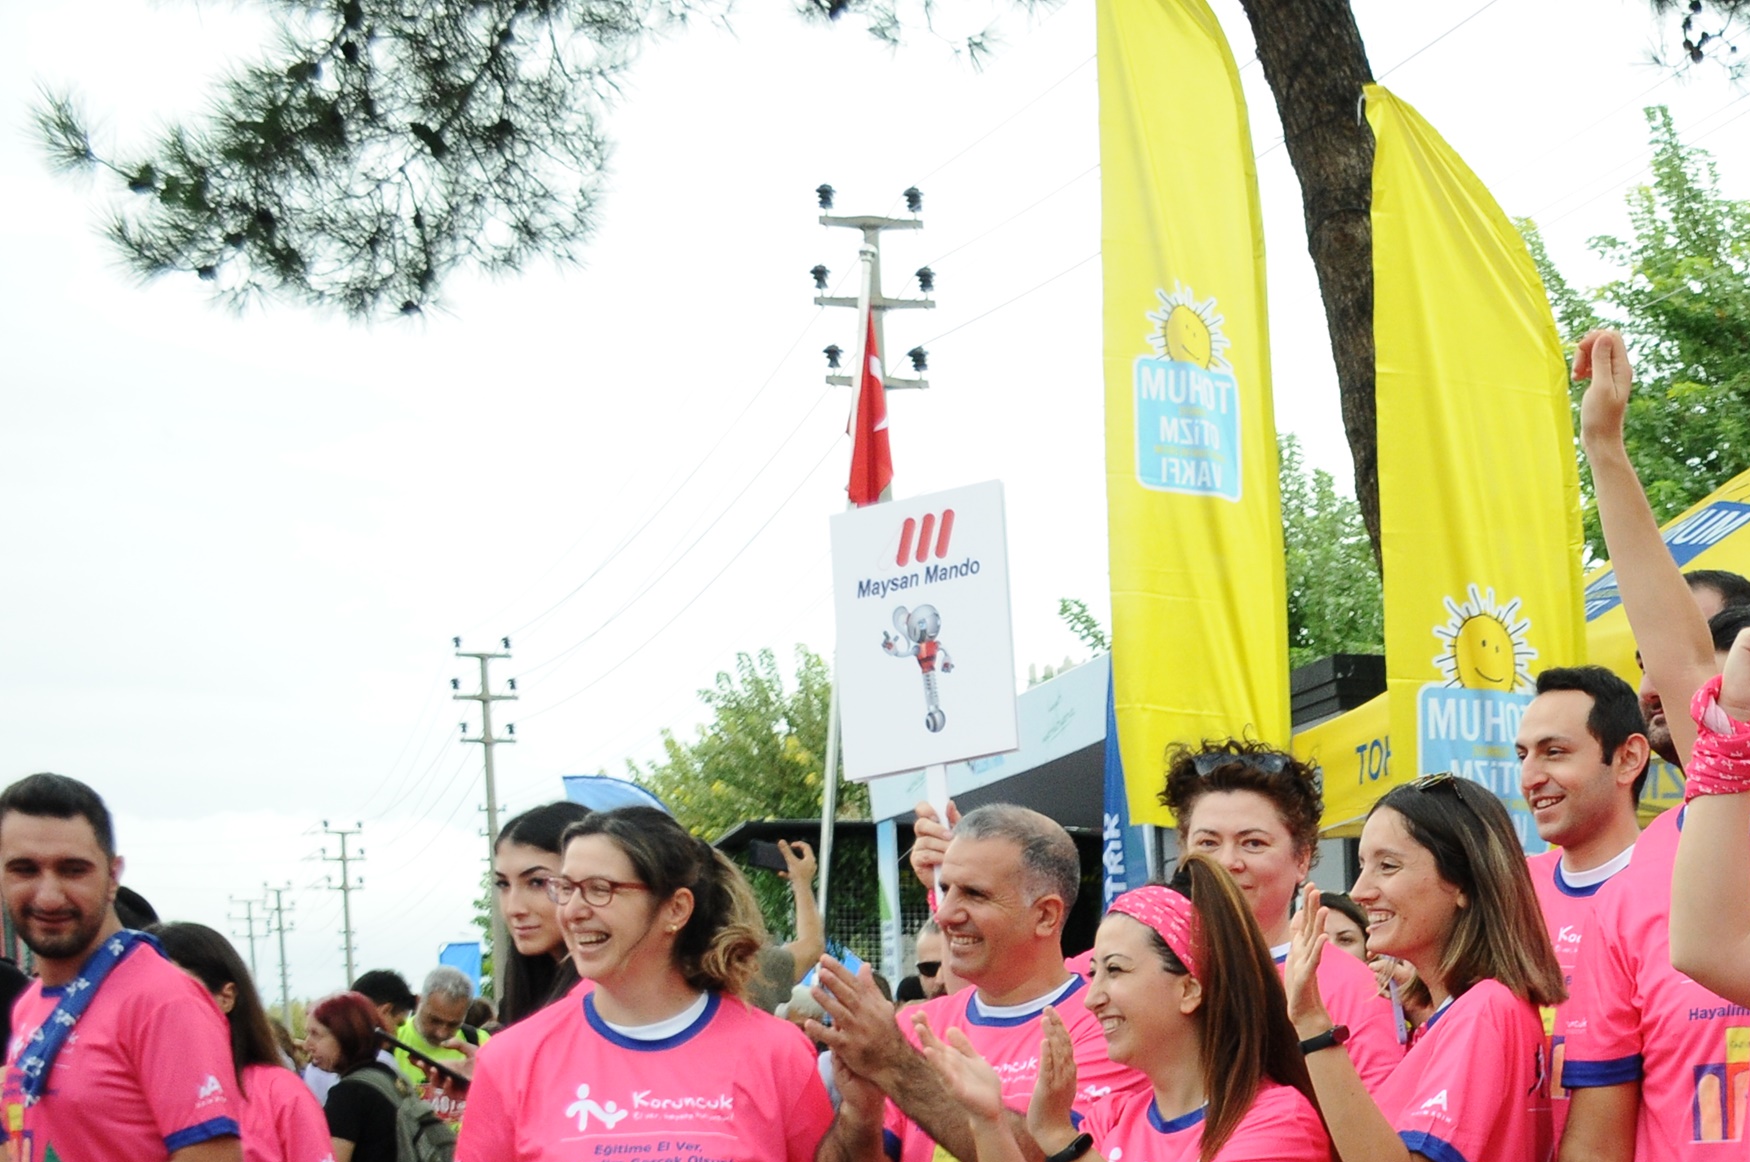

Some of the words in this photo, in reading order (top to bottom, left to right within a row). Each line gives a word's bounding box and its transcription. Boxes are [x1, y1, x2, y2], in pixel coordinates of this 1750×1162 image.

[857, 572, 919, 600] Maysan
[924, 558, 980, 585] Mando
[1688, 1003, 1750, 1021] Hayalim
[632, 1089, 734, 1110] Koruncuk
[594, 1143, 652, 1157] Eğitime
[657, 1140, 670, 1152] El
